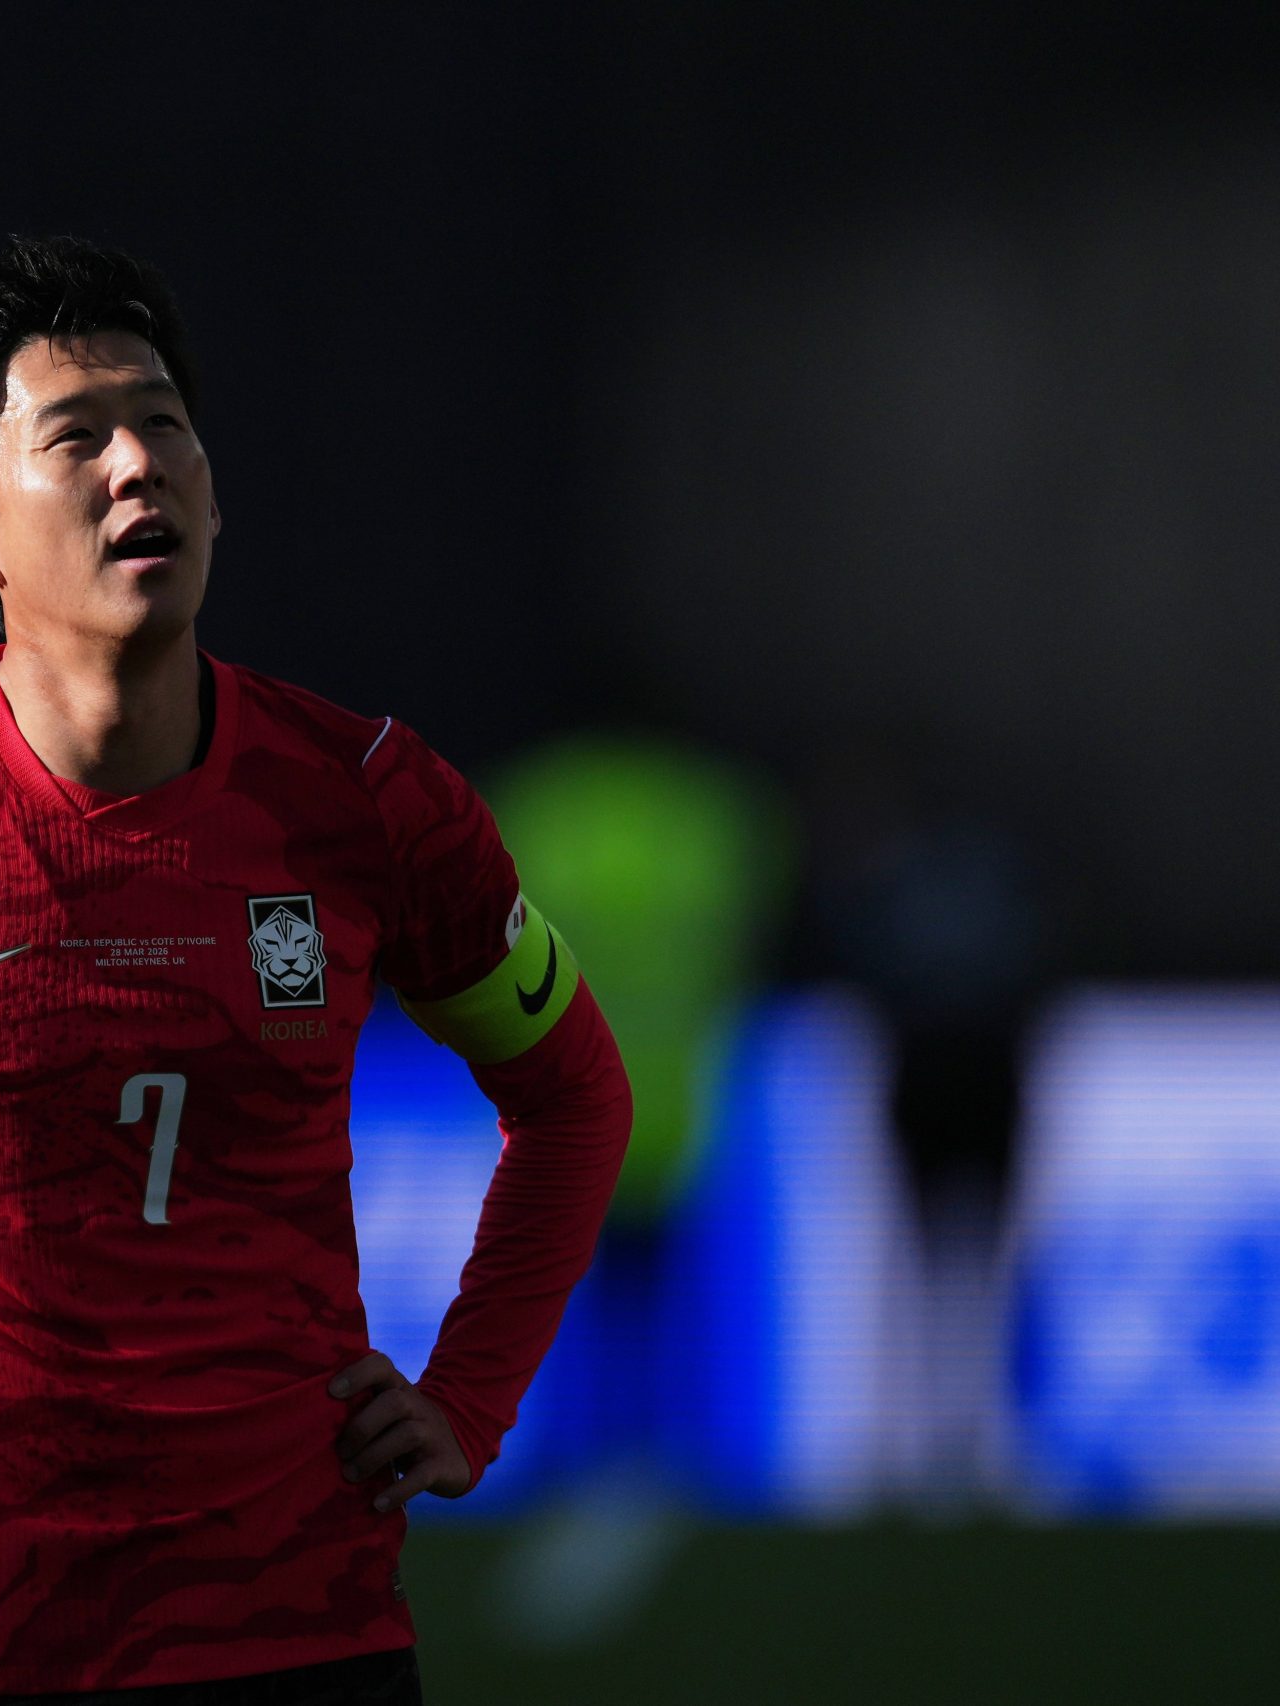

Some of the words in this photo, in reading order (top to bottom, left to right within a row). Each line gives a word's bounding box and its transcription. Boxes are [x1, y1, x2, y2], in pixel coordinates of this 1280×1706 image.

[60, 939, 90, 947] KOREA
[93, 938, 137, 947] REPUBLIC
[151, 937, 174, 946] COTE
[177, 936, 216, 945] D'IVOIRE
[111, 948, 121, 957] 28
[124, 948, 144, 956] MAR
[147, 947, 168, 956] 2026
[95, 958, 130, 967] MILTON
[132, 957, 170, 966] KEYNES,
[172, 957, 185, 965] UK
[260, 1020, 328, 1041] KOREA
[115, 1073, 187, 1225] 7
